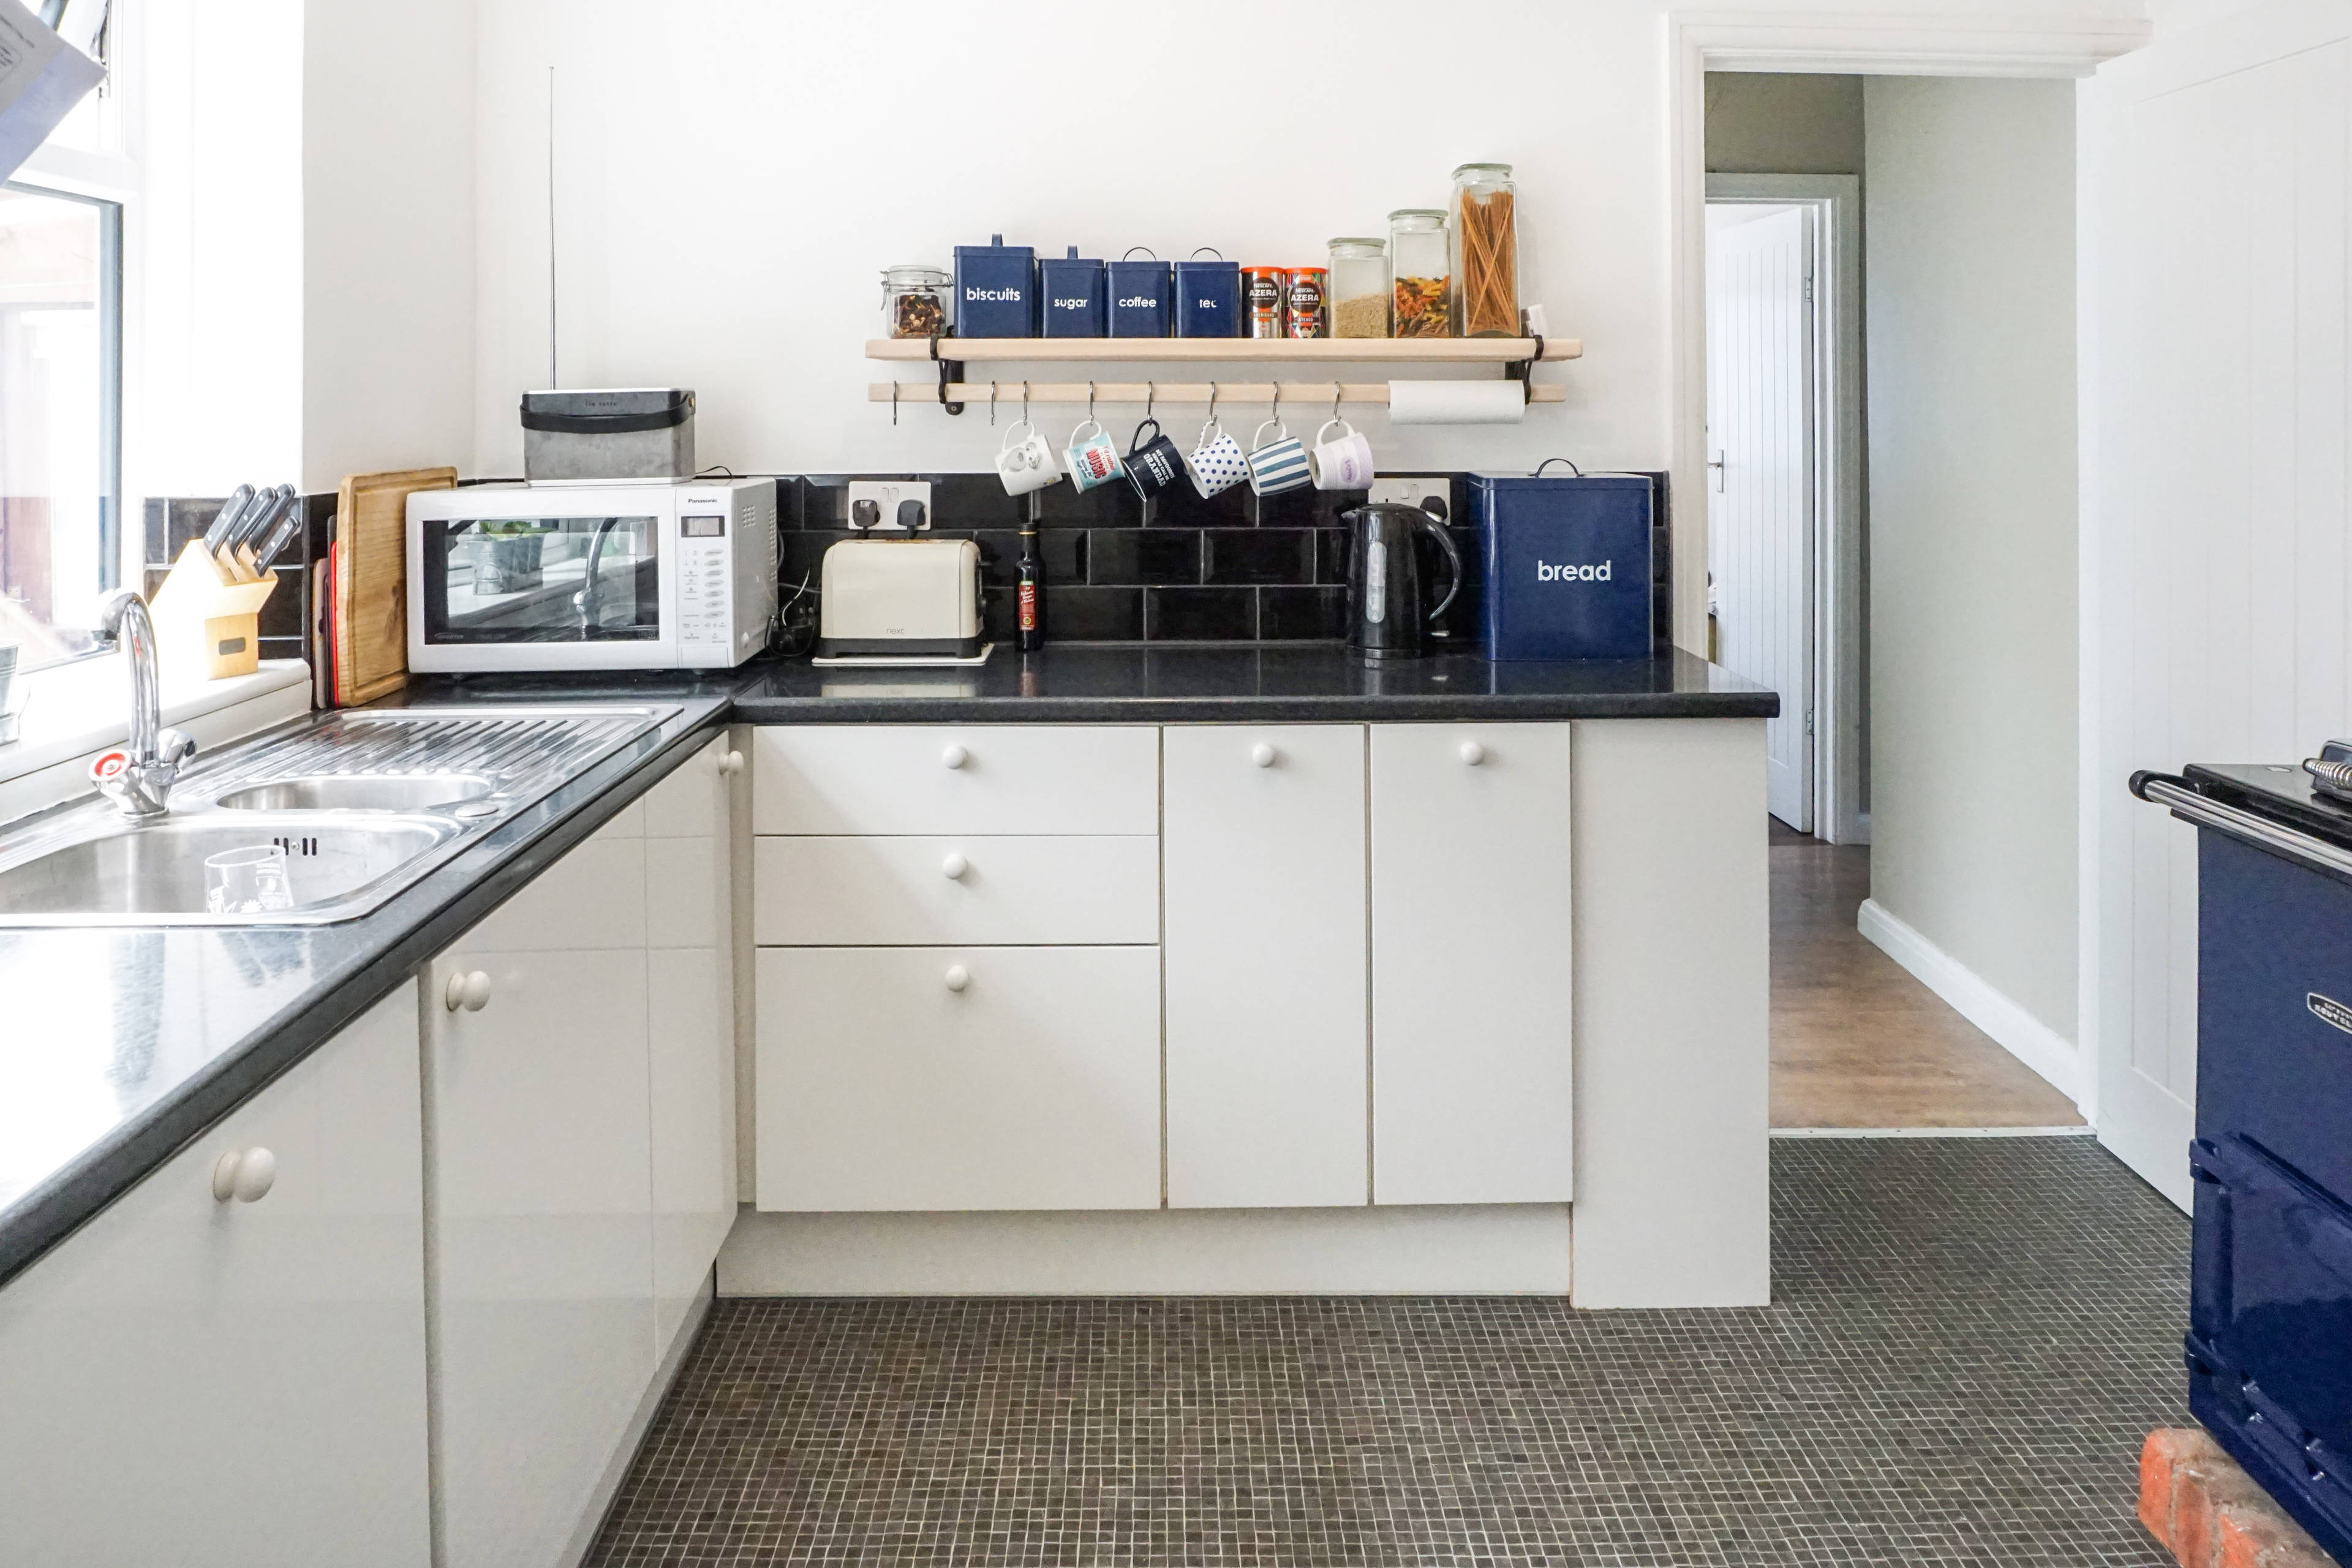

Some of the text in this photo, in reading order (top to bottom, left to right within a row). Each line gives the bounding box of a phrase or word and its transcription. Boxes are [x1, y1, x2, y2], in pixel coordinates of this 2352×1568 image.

[967, 287, 1020, 301] biscuits
[1054, 298, 1088, 310] sugar
[1119, 296, 1157, 307] coffee
[1155, 448, 1163, 457] MY
[1087, 448, 1107, 479] MUSIC
[1143, 453, 1166, 488] GRANDAD
[1538, 560, 1611, 581] bread
